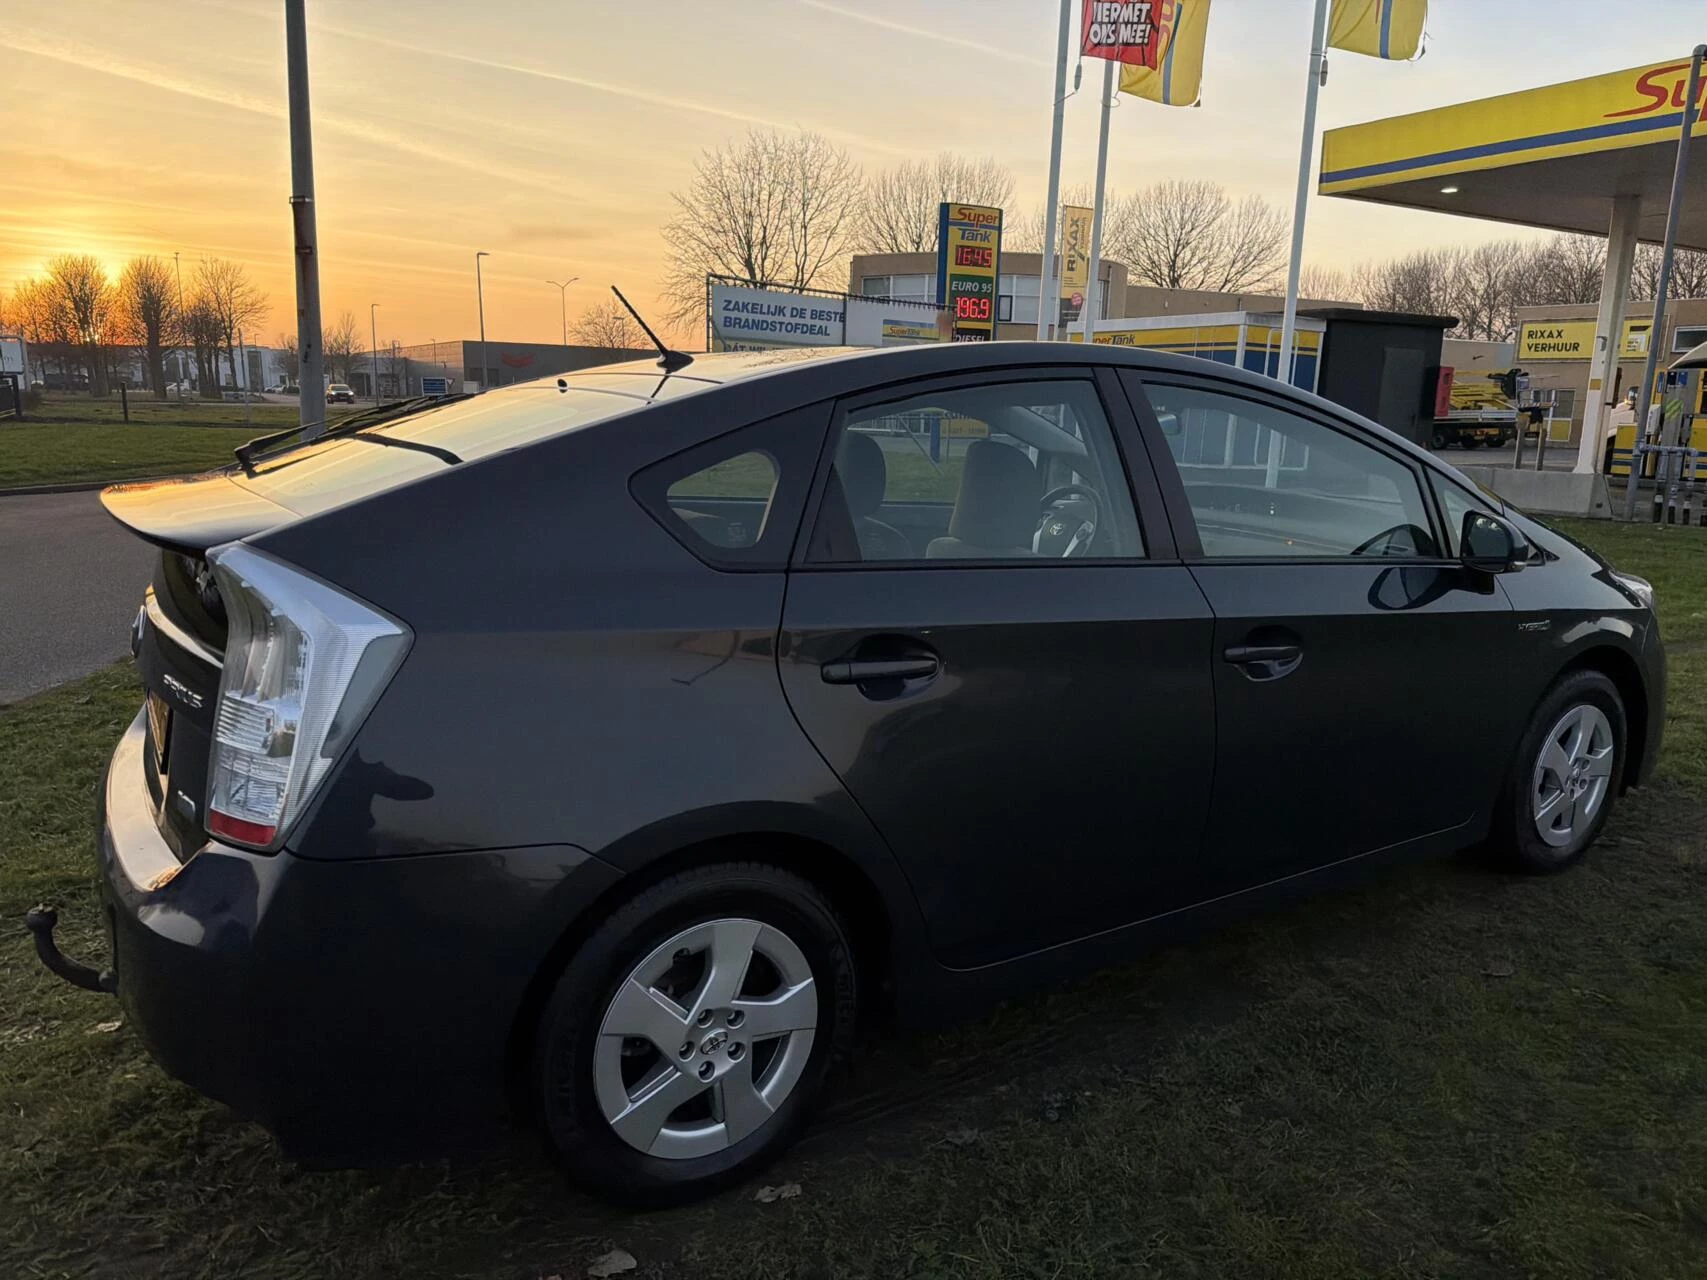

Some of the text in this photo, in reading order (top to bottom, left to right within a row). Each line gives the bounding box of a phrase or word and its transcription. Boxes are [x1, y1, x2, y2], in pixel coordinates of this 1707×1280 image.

[1118, 24, 1152, 44] MEE!
[949, 207, 998, 229] Super
[957, 228, 992, 243] Tank
[1066, 217, 1085, 272] RIXAX
[951, 281, 993, 293] EURO 95
[722, 299, 845, 323] ZAKELIJK DE BESTE
[955, 297, 990, 319] 196.9
[722, 316, 831, 337] BRANDSTOFDEAL
[1527, 329, 1564, 340] RIXAX
[1527, 342, 1581, 353] VERHUUR
